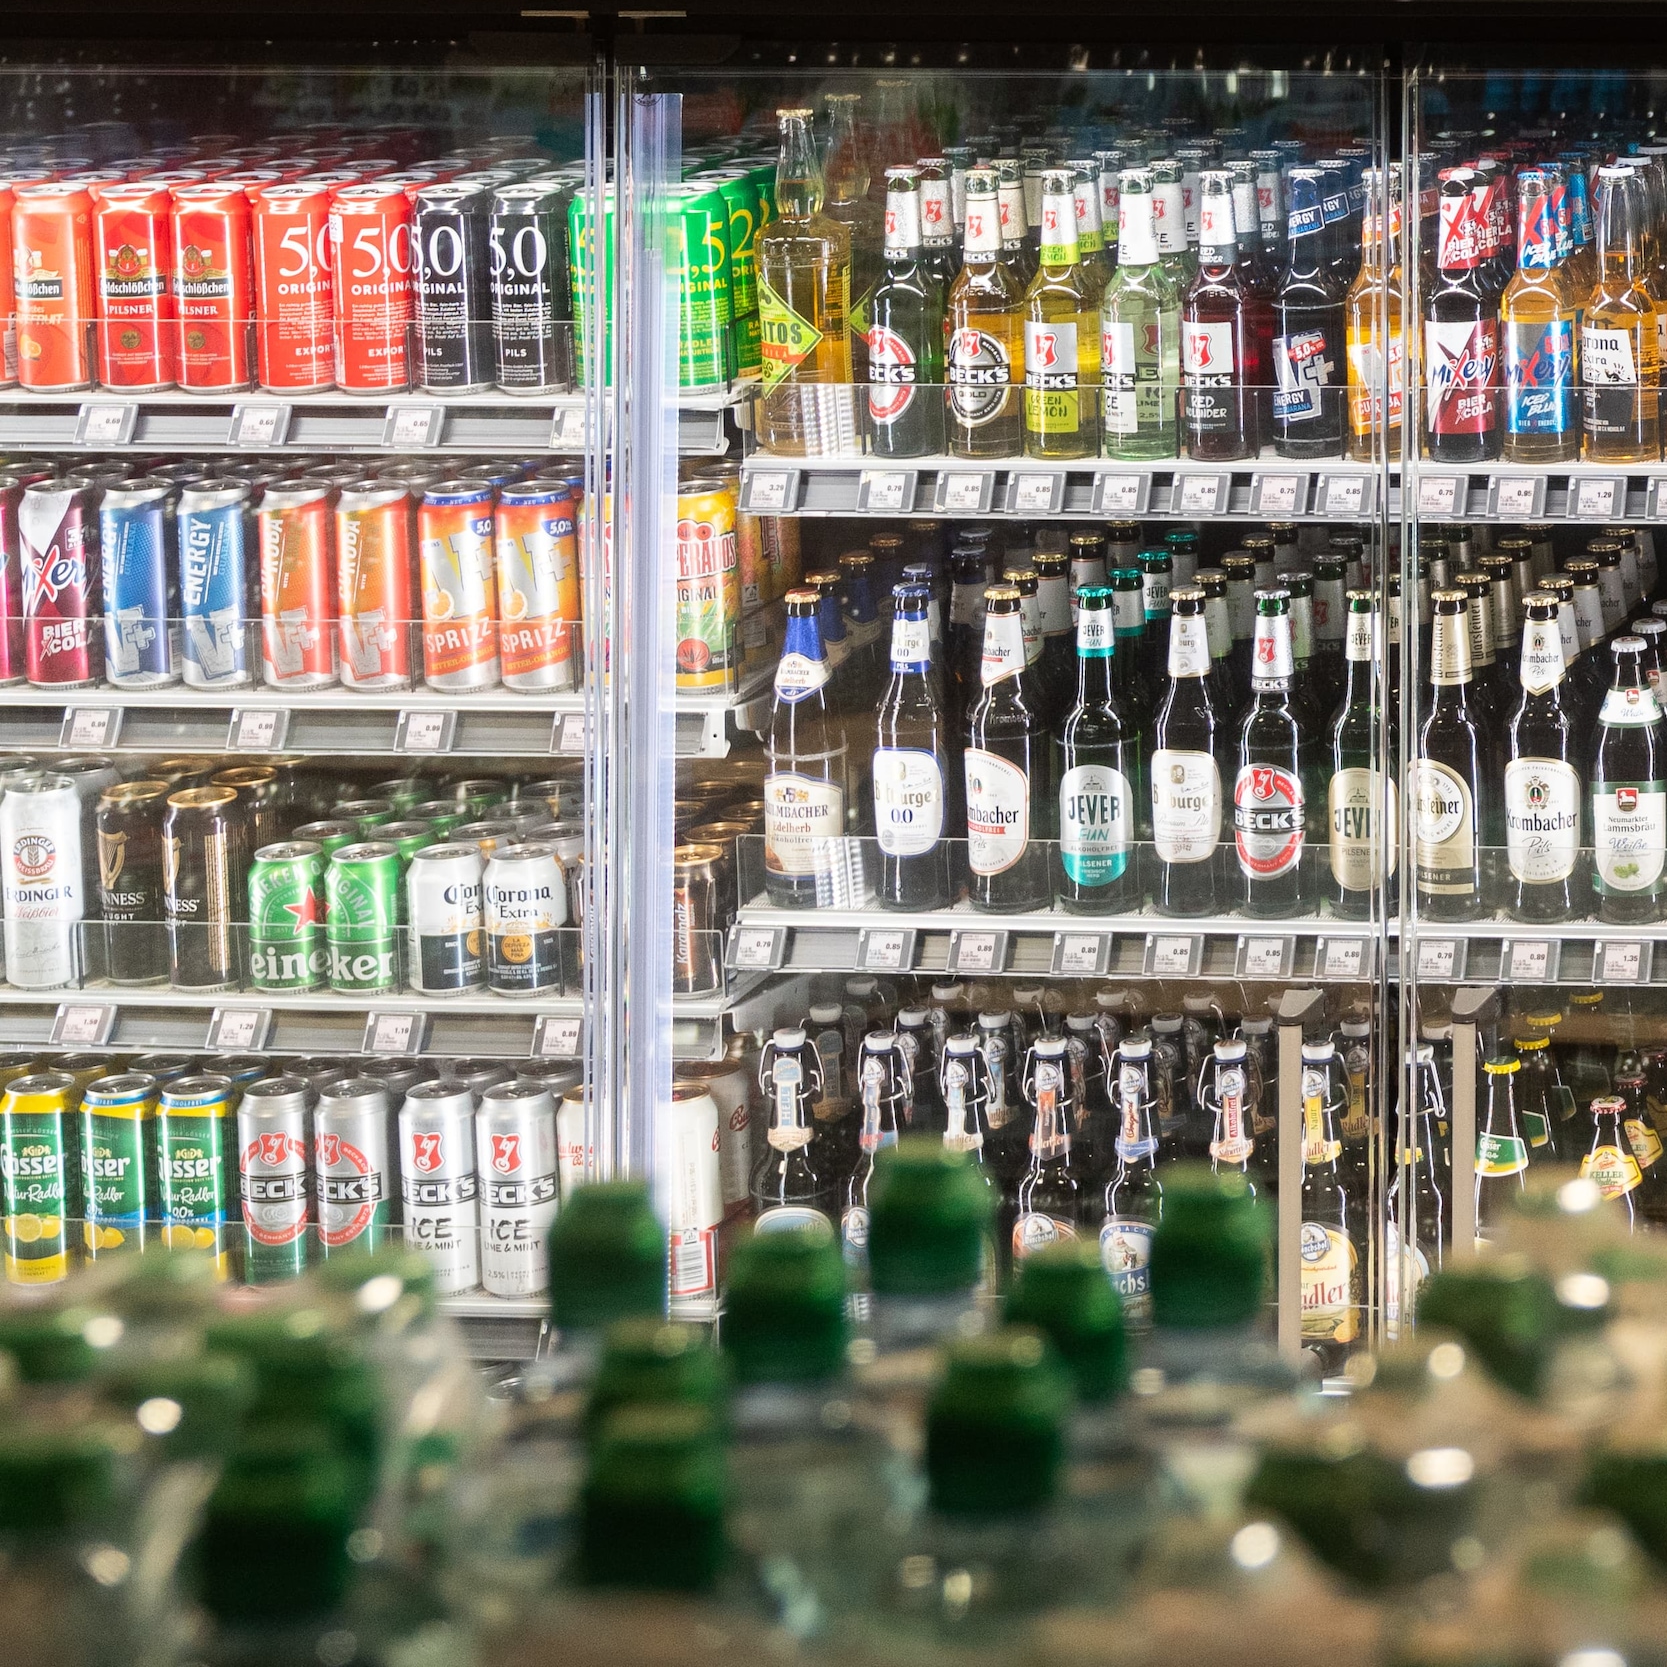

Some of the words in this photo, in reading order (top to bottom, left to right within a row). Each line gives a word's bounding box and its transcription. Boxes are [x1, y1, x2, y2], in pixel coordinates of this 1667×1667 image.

[506, 348, 527, 357] PILS
[1026, 375, 1077, 389] BECK'S
[1029, 395, 1062, 407] GREEN
[1191, 395, 1215, 409] RED
[1457, 394, 1486, 410] BIER
[1028, 404, 1069, 418] LEMON
[965, 485, 980, 493] 0.85
[184, 518, 212, 605] ENERGY
[1145, 586, 1168, 601] JEVER
[43, 620, 85, 640] BIER
[426, 618, 492, 654] SPRIZZ
[501, 617, 566, 654] SPRIZZ
[1082, 624, 1105, 637] JEVER
[1471, 603, 1482, 661] Warsteiner
[1432, 621, 1444, 679] Warsteiner
[1251, 679, 1288, 690] BECK'S
[1067, 795, 1121, 825] JEVER
[1234, 810, 1305, 831] BECK'S
[1506, 810, 1577, 833] Krombacher
[1608, 815, 1649, 824] Neumarkter
[1080, 827, 1110, 842] FUN
[13, 836, 55, 854] ERDINGER
[1522, 835, 1553, 858] Pils
[500, 904, 538, 918] Extra
[675, 902, 687, 965] Karamalz
[885, 942, 901, 950] 0.85
[1081, 946, 1097, 954] 0.89
[1623, 954, 1638, 962] 1.35
[1228, 1096, 1239, 1138] Alkoholfrei
[412, 1217, 452, 1239] ICE
[490, 1219, 531, 1241] ICE
